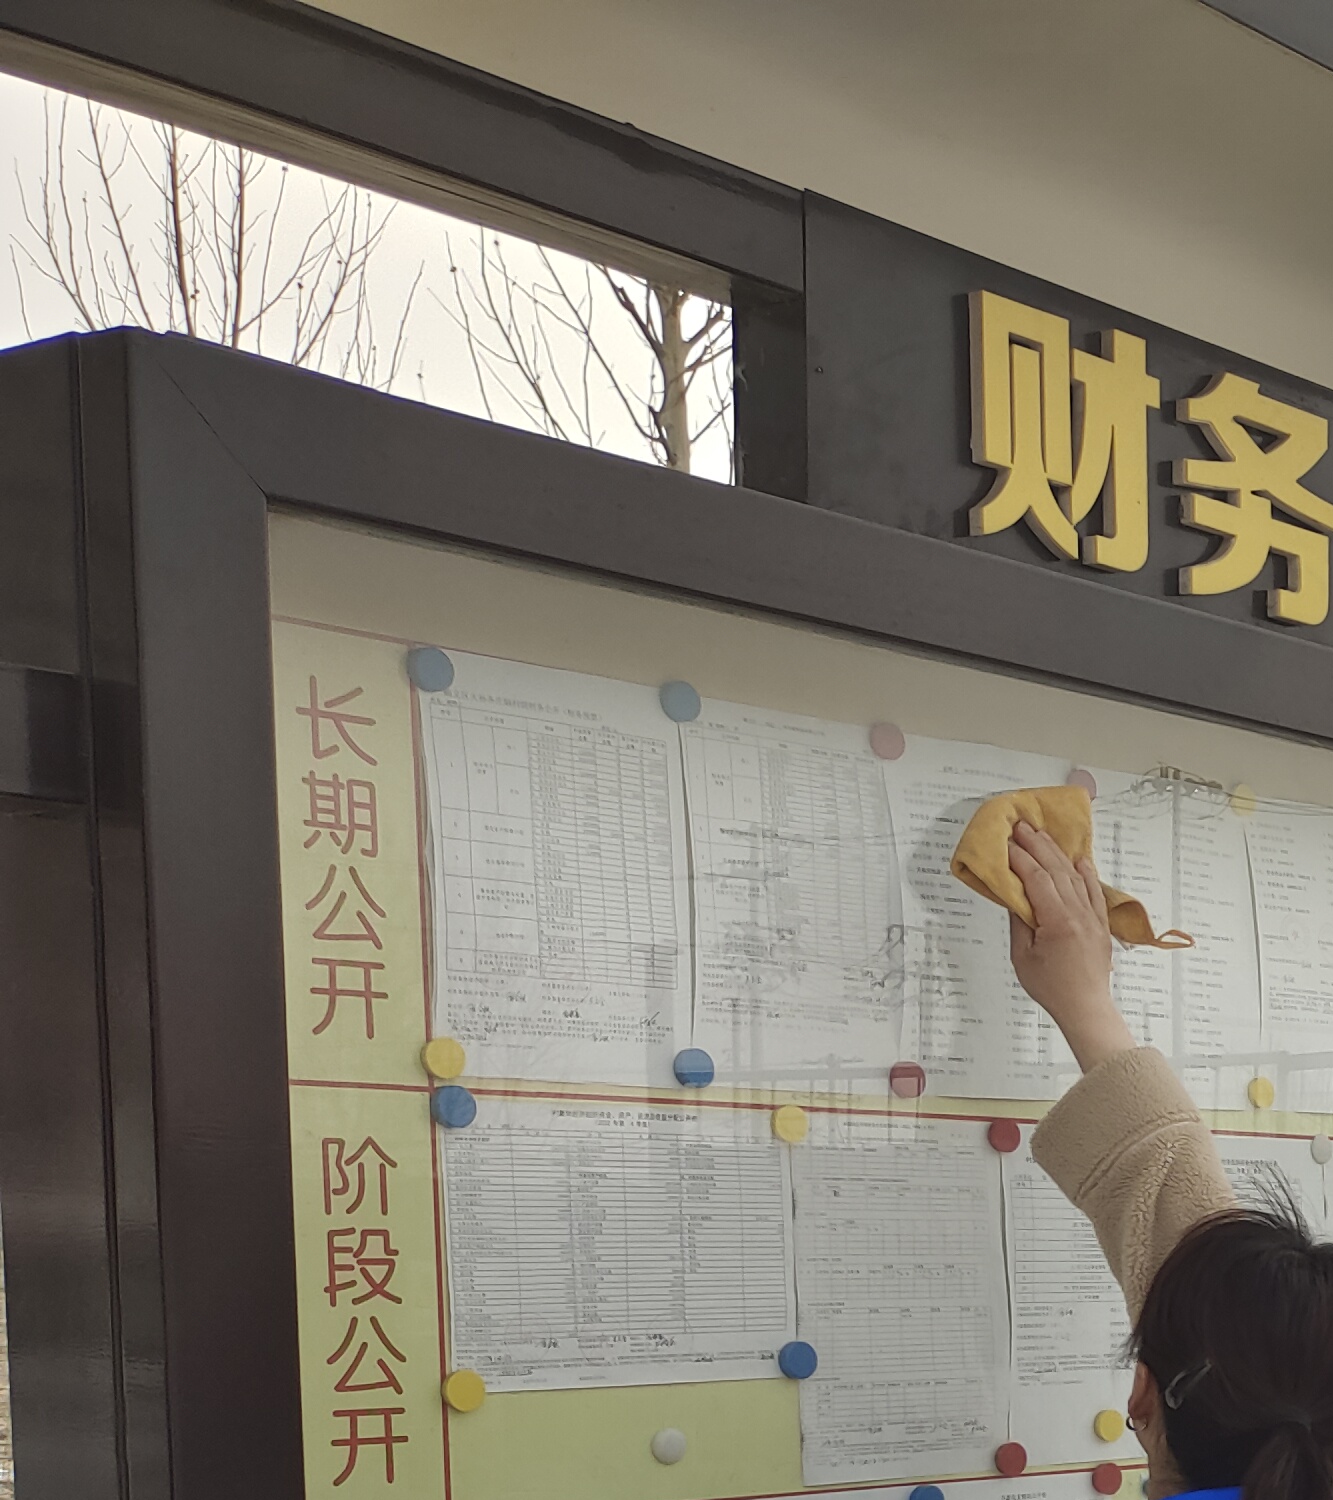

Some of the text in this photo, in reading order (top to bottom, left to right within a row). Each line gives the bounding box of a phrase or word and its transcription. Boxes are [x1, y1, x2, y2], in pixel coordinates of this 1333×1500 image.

[296, 675, 387, 1040] 长期公开
[321, 1136, 409, 1487] 阶段公开
